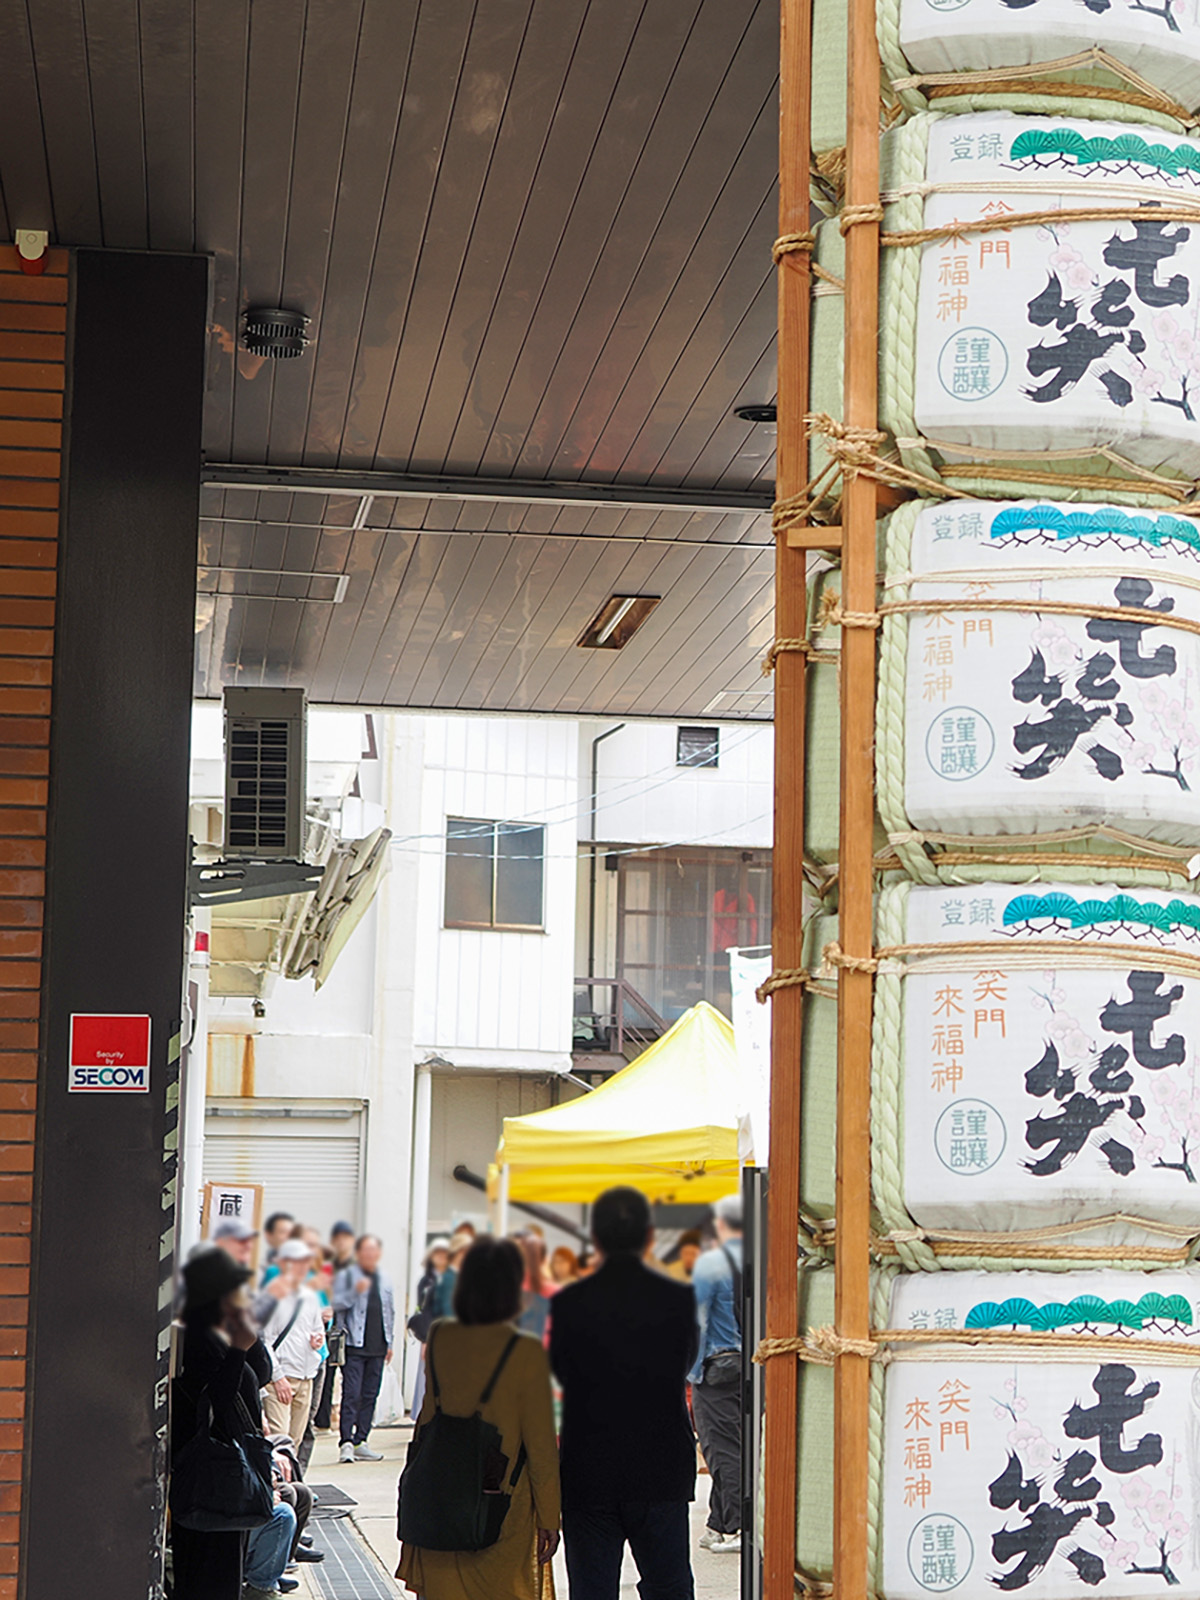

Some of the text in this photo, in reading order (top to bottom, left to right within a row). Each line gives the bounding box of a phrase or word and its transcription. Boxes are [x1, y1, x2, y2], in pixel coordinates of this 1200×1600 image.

[949, 133, 1004, 162] 登録
[931, 512, 984, 542] 登録
[940, 898, 996, 927] 登録
[973, 970, 1008, 1039] 笑門
[96, 1050, 124, 1059] Security
[105, 1058, 115, 1066] by
[74, 1068, 144, 1085] SECOM
[219, 1193, 243, 1217] 蔵
[938, 1378, 971, 1452] 笑門
